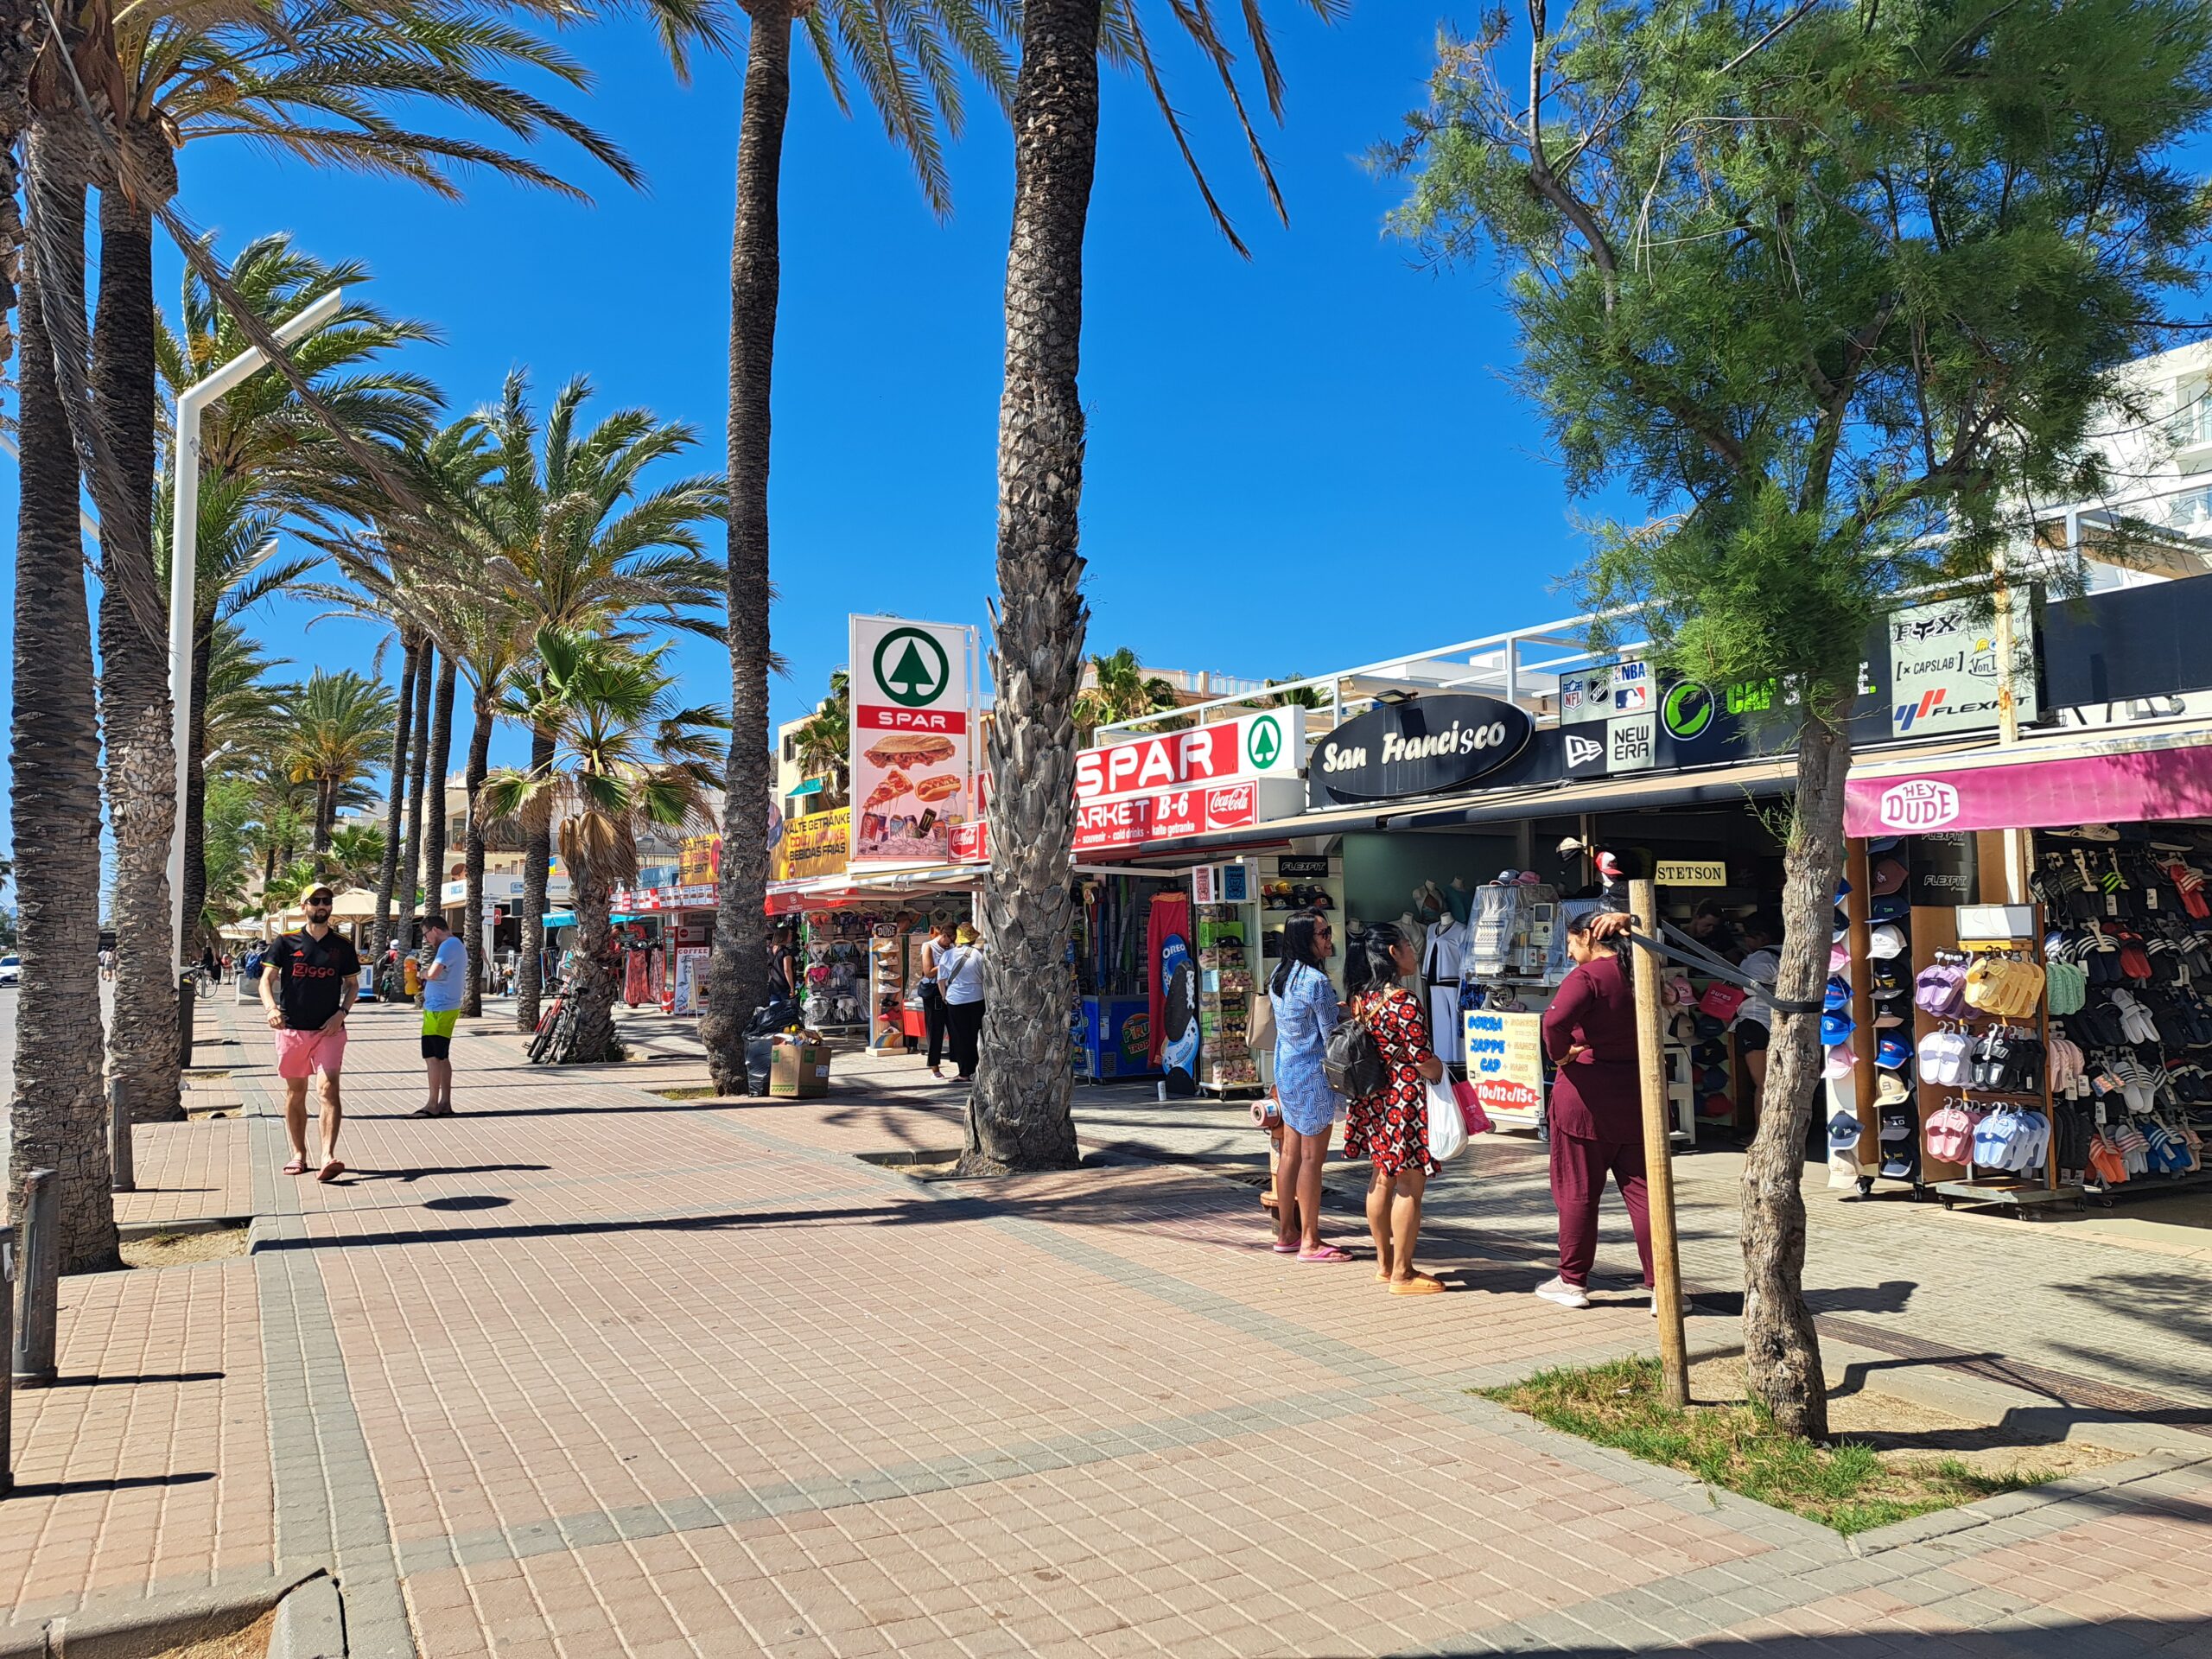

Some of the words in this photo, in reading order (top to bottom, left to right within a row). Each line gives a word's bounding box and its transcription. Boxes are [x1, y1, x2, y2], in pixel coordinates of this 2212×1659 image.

[1622, 662, 1646, 681] NBA
[1913, 657, 1955, 675] CAPSLAB
[1971, 657, 1991, 673] Von
[1565, 692, 1582, 707] NFL
[1932, 696, 2031, 717] FLEXFT
[878, 711, 946, 729] SPAR
[1614, 724, 1649, 745] NEW
[1323, 741, 1367, 773] San
[1381, 719, 1506, 765] Francisco
[1614, 741, 1649, 761] ERA
[1076, 730, 1214, 798] SPAR
[1211, 787, 1250, 814] Coca-Cola
[1902, 783, 1936, 800] HEY
[1076, 798, 1150, 830] ARKET
[1155, 791, 1189, 820] B-6
[1885, 790, 1952, 824] DUDE
[784, 821, 807, 836] KALTE
[1082, 831, 1106, 844] souvenir
[1112, 828, 1126, 841] cold
[1126, 826, 1145, 839] drinks
[1152, 823, 1166, 836] kalte
[789, 846, 822, 861] BEBIDAS
[1281, 861, 1326, 871] FLEXFIT
[1657, 867, 1722, 880] STETSON
[1923, 875, 1967, 887] FLEXFIT
[1162, 944, 1186, 959] OREO
[1479, 1058, 1502, 1073] CAP
